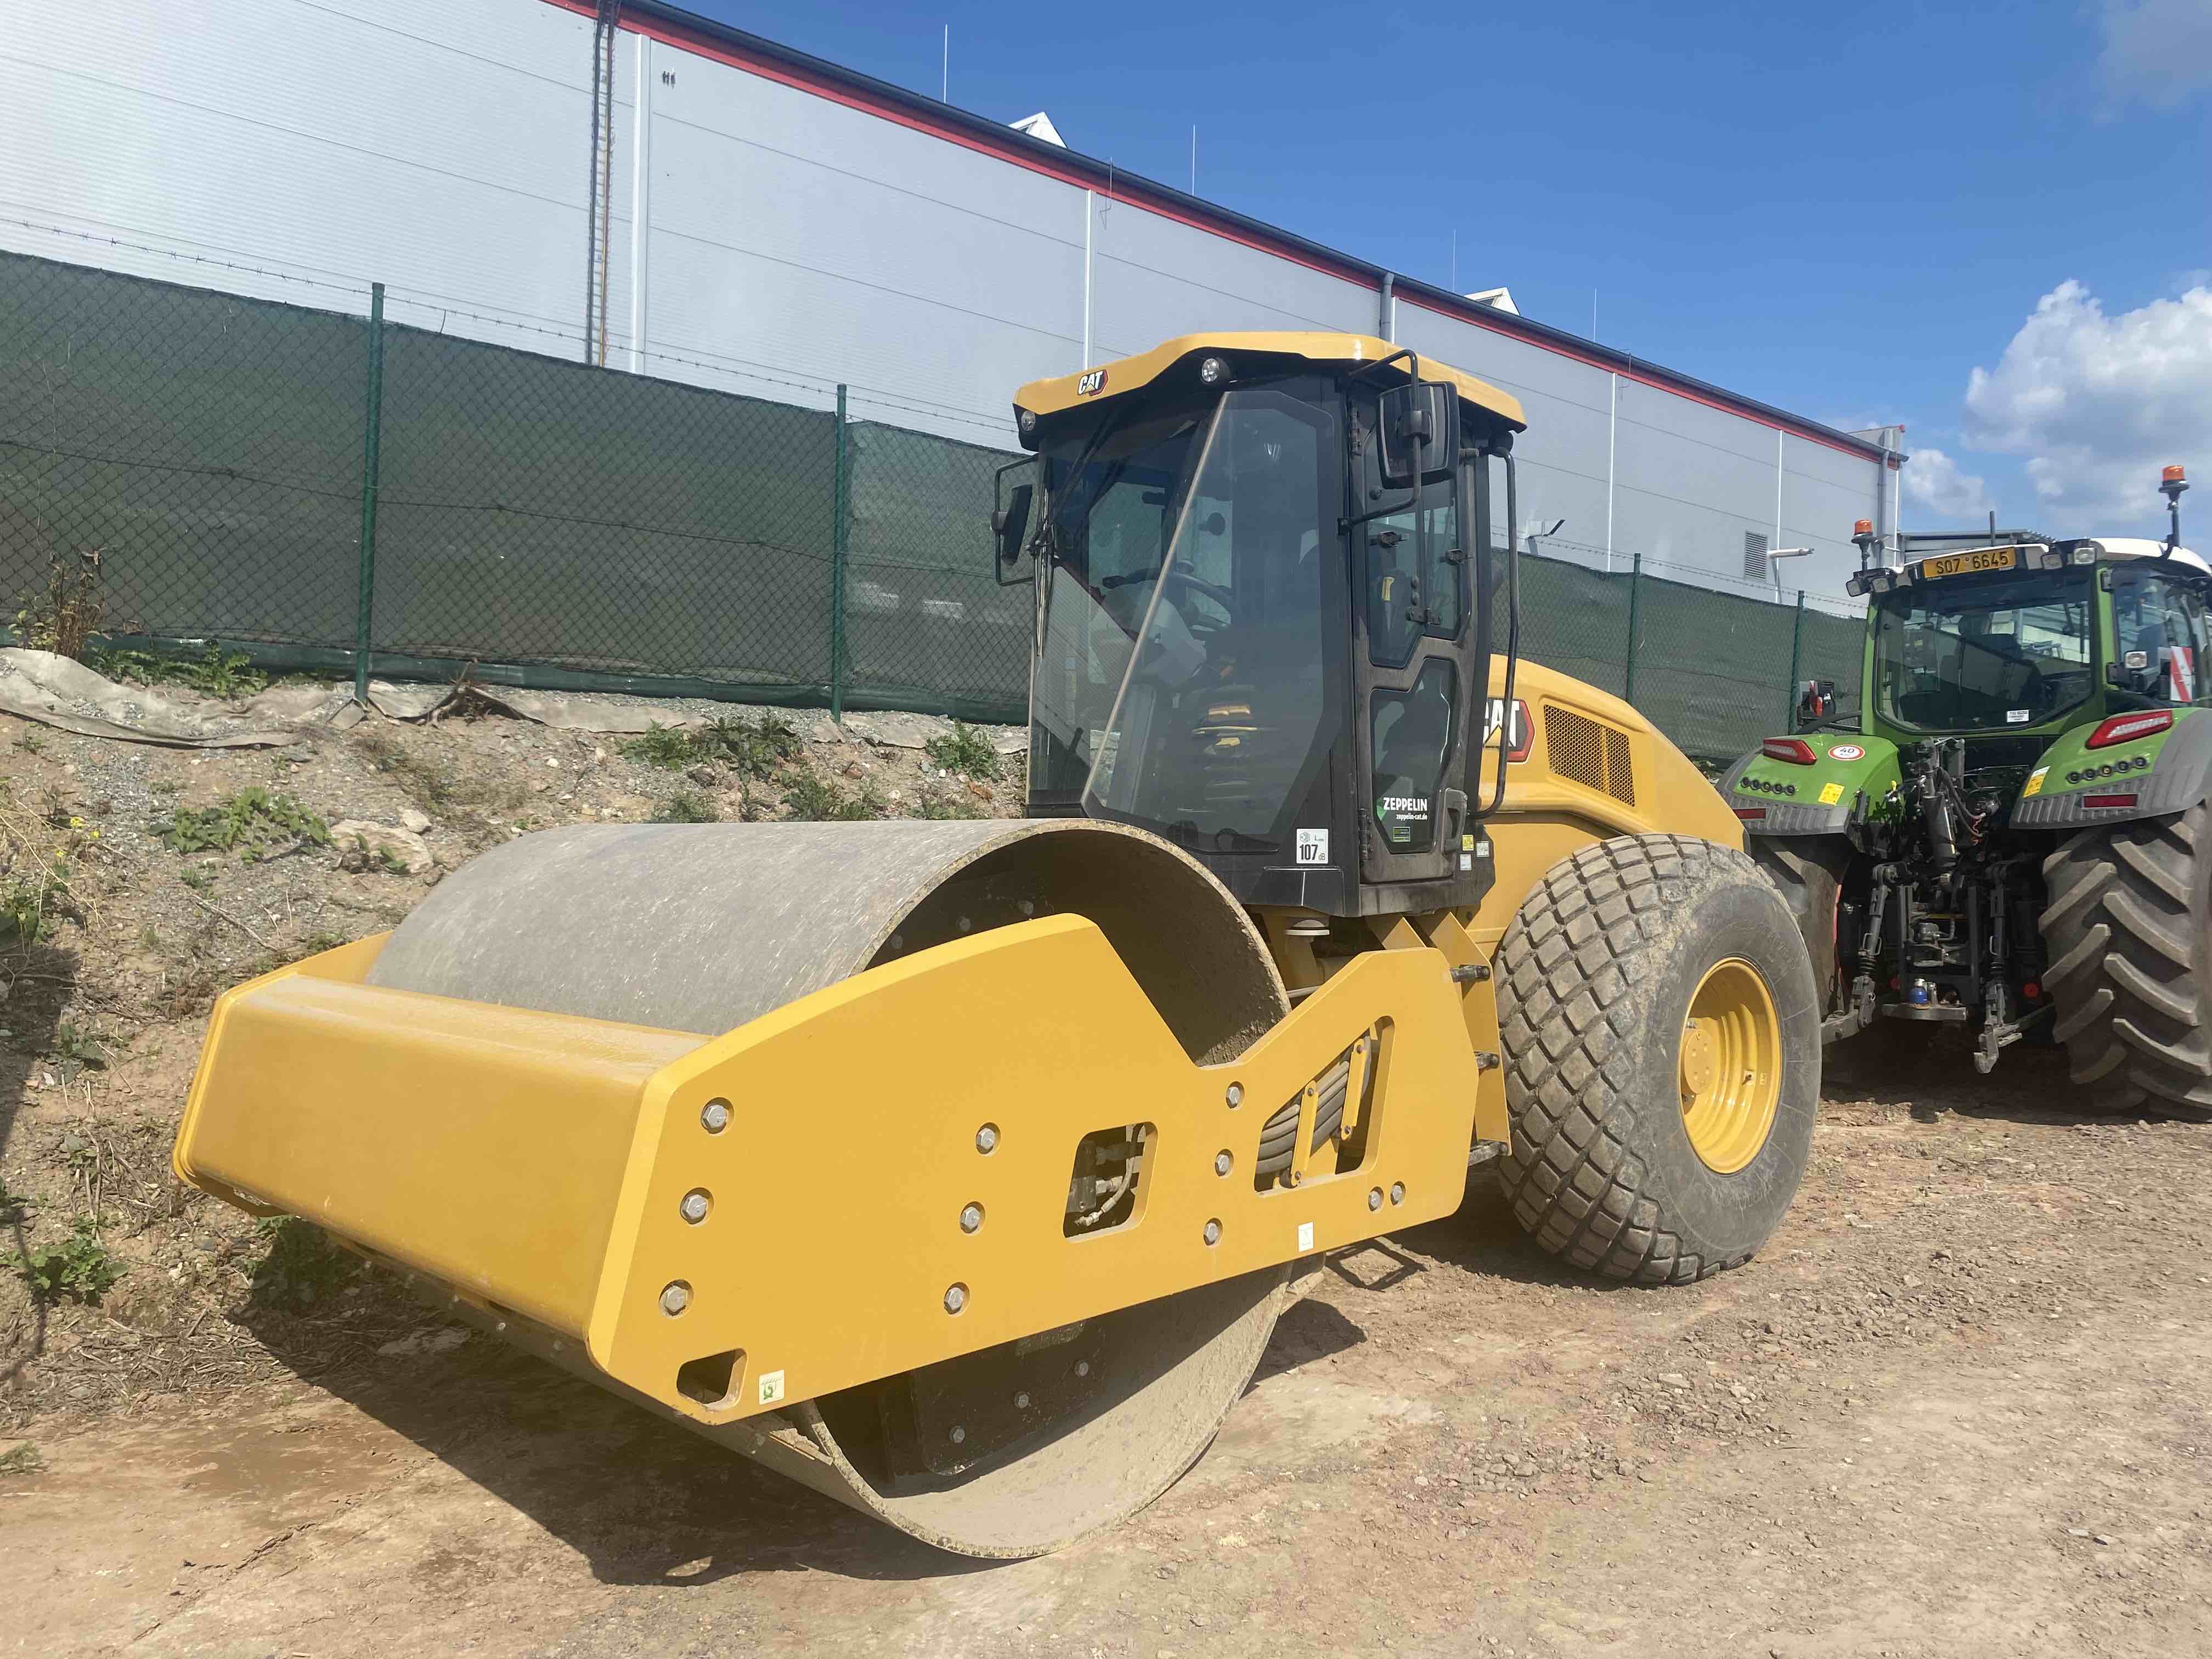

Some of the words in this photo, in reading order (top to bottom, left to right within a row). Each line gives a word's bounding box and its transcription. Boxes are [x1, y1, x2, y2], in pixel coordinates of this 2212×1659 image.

[1078, 371, 1103, 395] CAT
[1973, 552, 2008, 569] 6645
[1383, 797, 1427, 811] ZEPPELIN
[1300, 844, 1318, 860] 107
